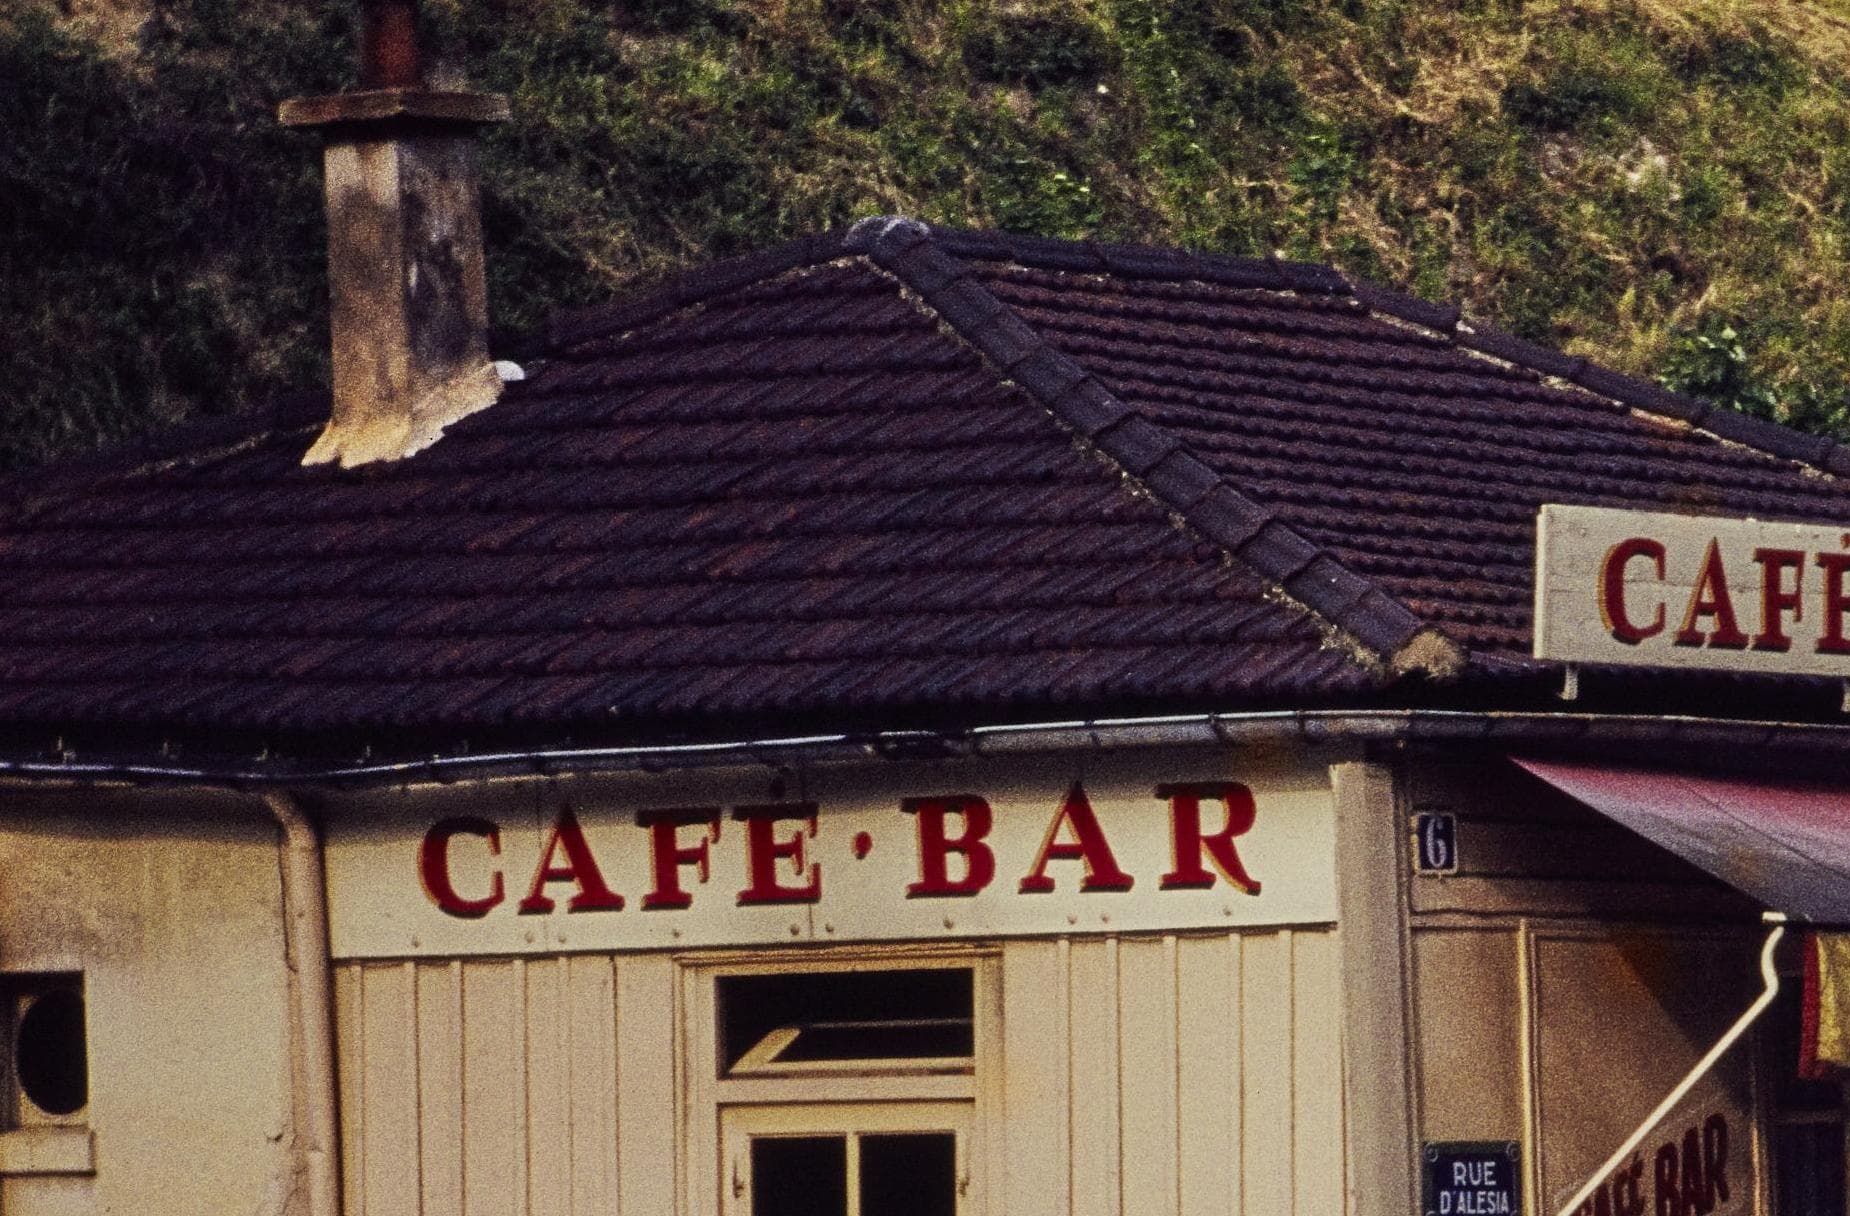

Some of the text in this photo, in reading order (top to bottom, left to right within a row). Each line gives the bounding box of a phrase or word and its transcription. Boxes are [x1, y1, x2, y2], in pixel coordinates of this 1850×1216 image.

[901, 781, 1262, 899] BAR
[1425, 817, 1448, 868] 6
[1453, 1161, 1497, 1186] RUE
[1440, 1190, 1509, 1215] D'ALESIA
